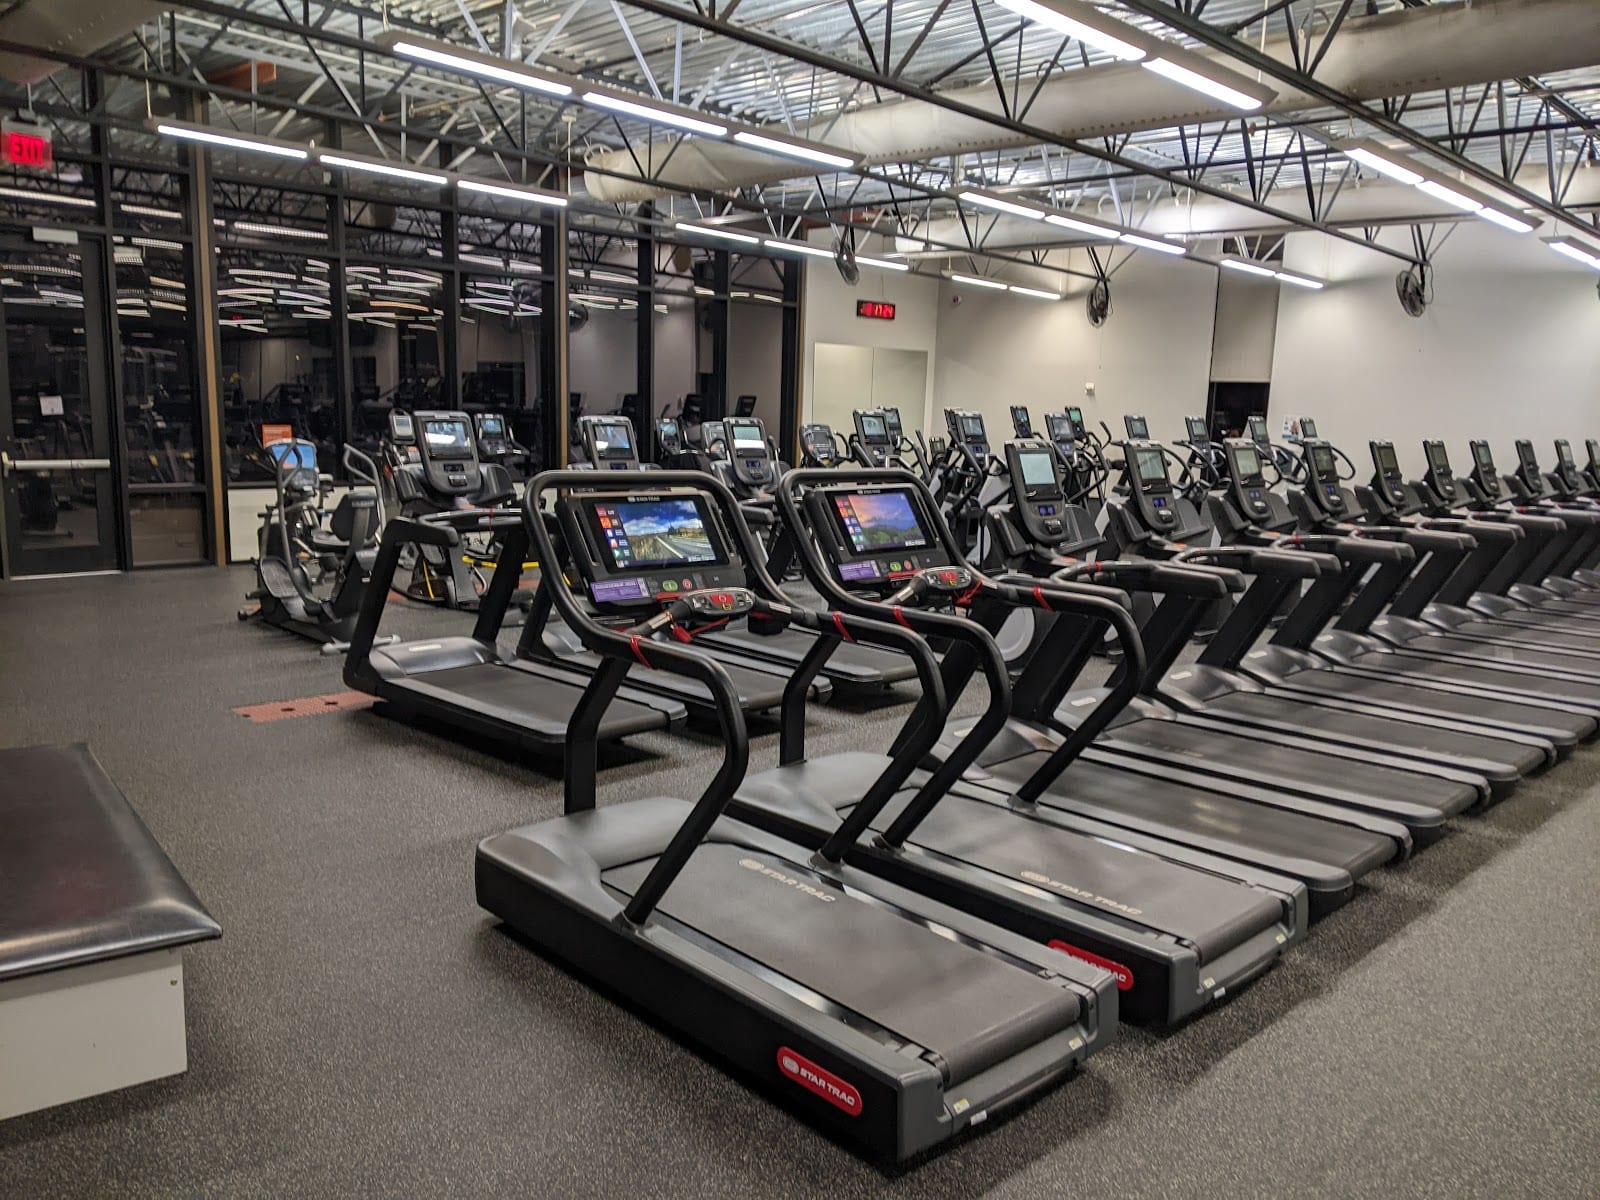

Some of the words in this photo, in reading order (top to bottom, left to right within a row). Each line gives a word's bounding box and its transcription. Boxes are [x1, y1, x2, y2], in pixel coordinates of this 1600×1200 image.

[9, 134, 44, 167] EXIT
[762, 868, 798, 885] STAR
[796, 883, 836, 902] TRAC
[1048, 881, 1093, 898] STAR
[1095, 896, 1142, 915] TRAC
[800, 1068, 826, 1090] STAR
[826, 1083, 855, 1107] TRAC
